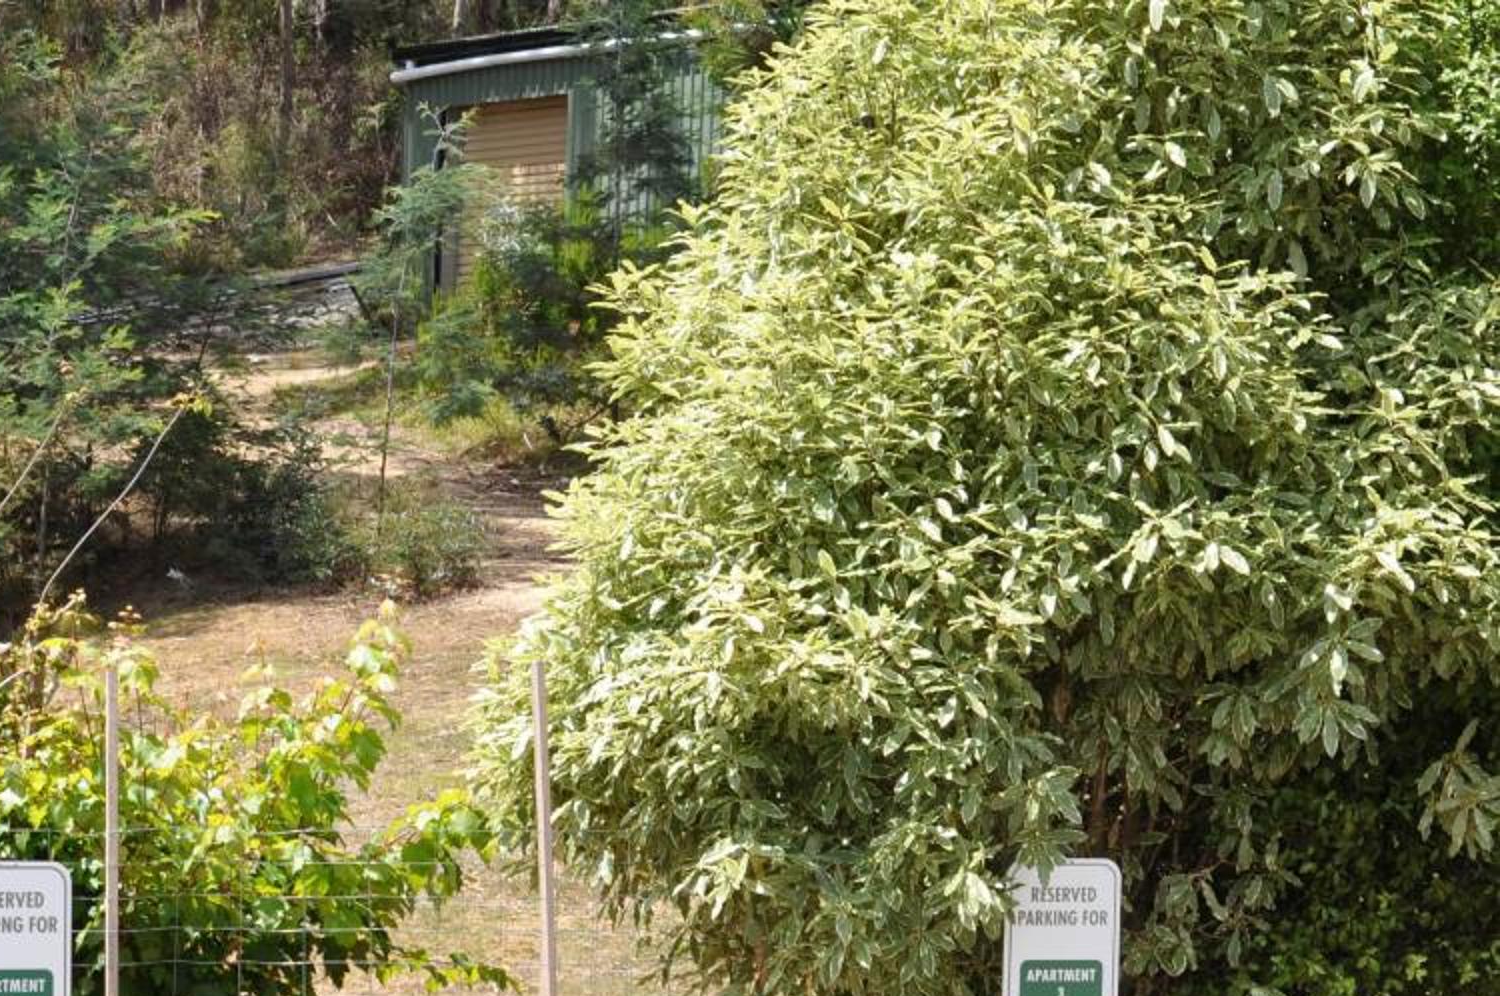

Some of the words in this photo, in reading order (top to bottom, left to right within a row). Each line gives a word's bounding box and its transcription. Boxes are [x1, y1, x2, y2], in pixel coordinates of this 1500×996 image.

[1031, 886, 1097, 903] RESERVED
[29, 916, 58, 933] FOR
[1017, 910, 1077, 926] PARKING
[1082, 910, 1108, 926] FOR
[1027, 968, 1096, 982] APARTMENT
